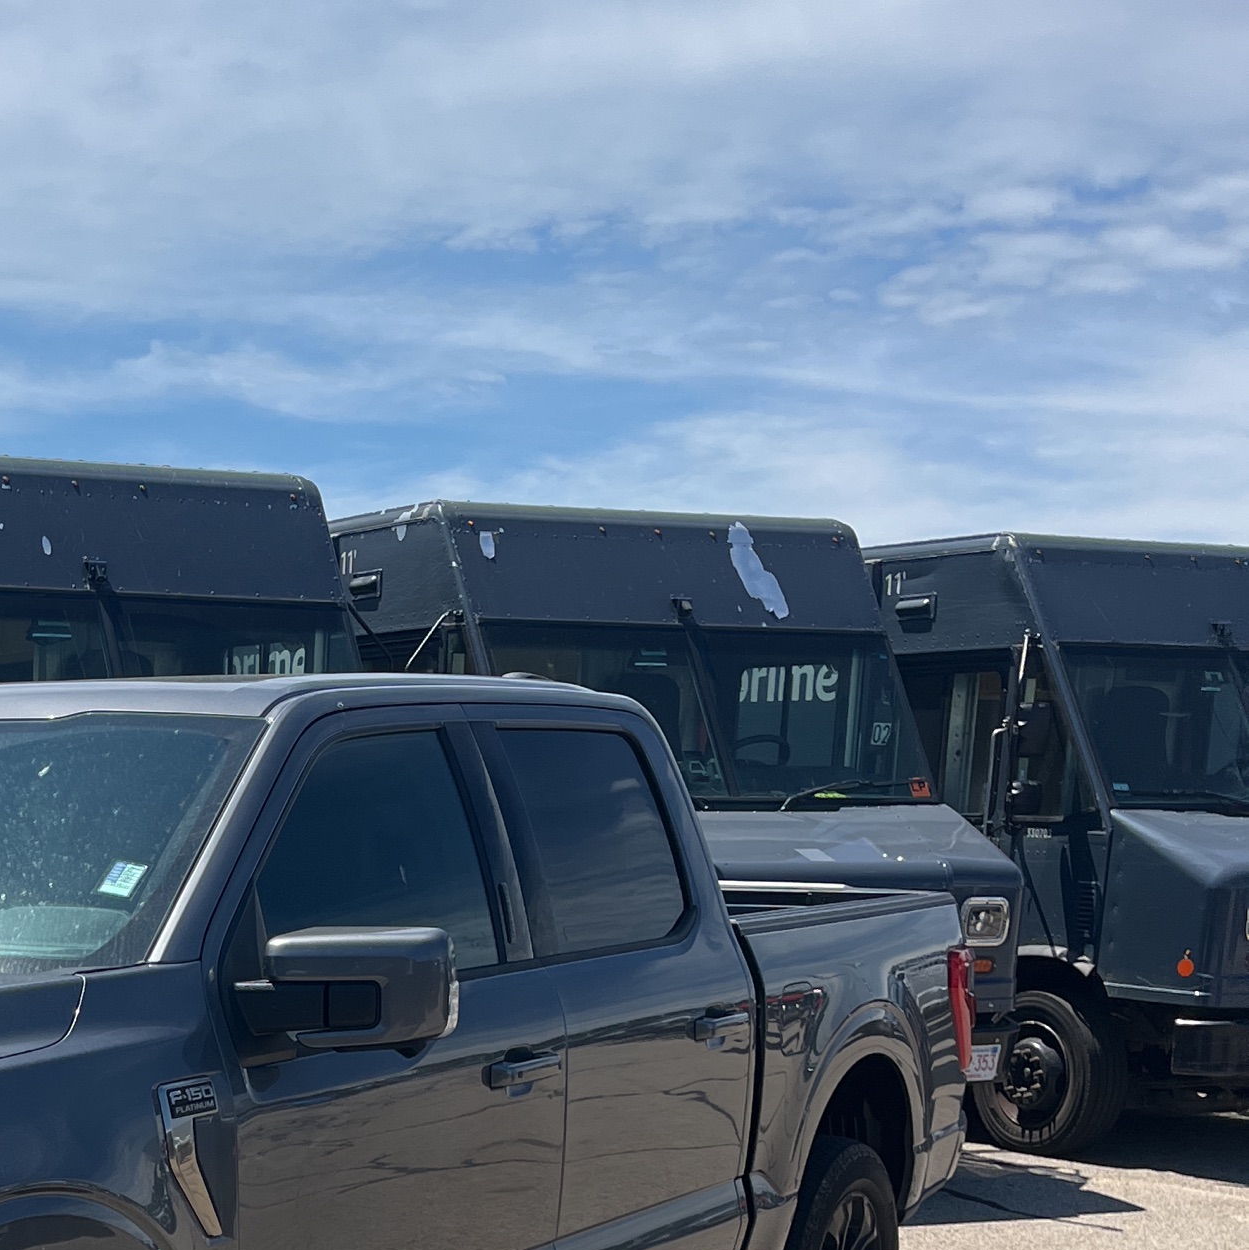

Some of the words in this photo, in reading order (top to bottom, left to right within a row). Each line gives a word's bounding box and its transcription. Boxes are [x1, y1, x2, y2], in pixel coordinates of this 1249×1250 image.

[873, 724, 891, 744] 02
[169, 1086, 214, 1105] F-150
[176, 1099, 215, 1114] PLATINUM
